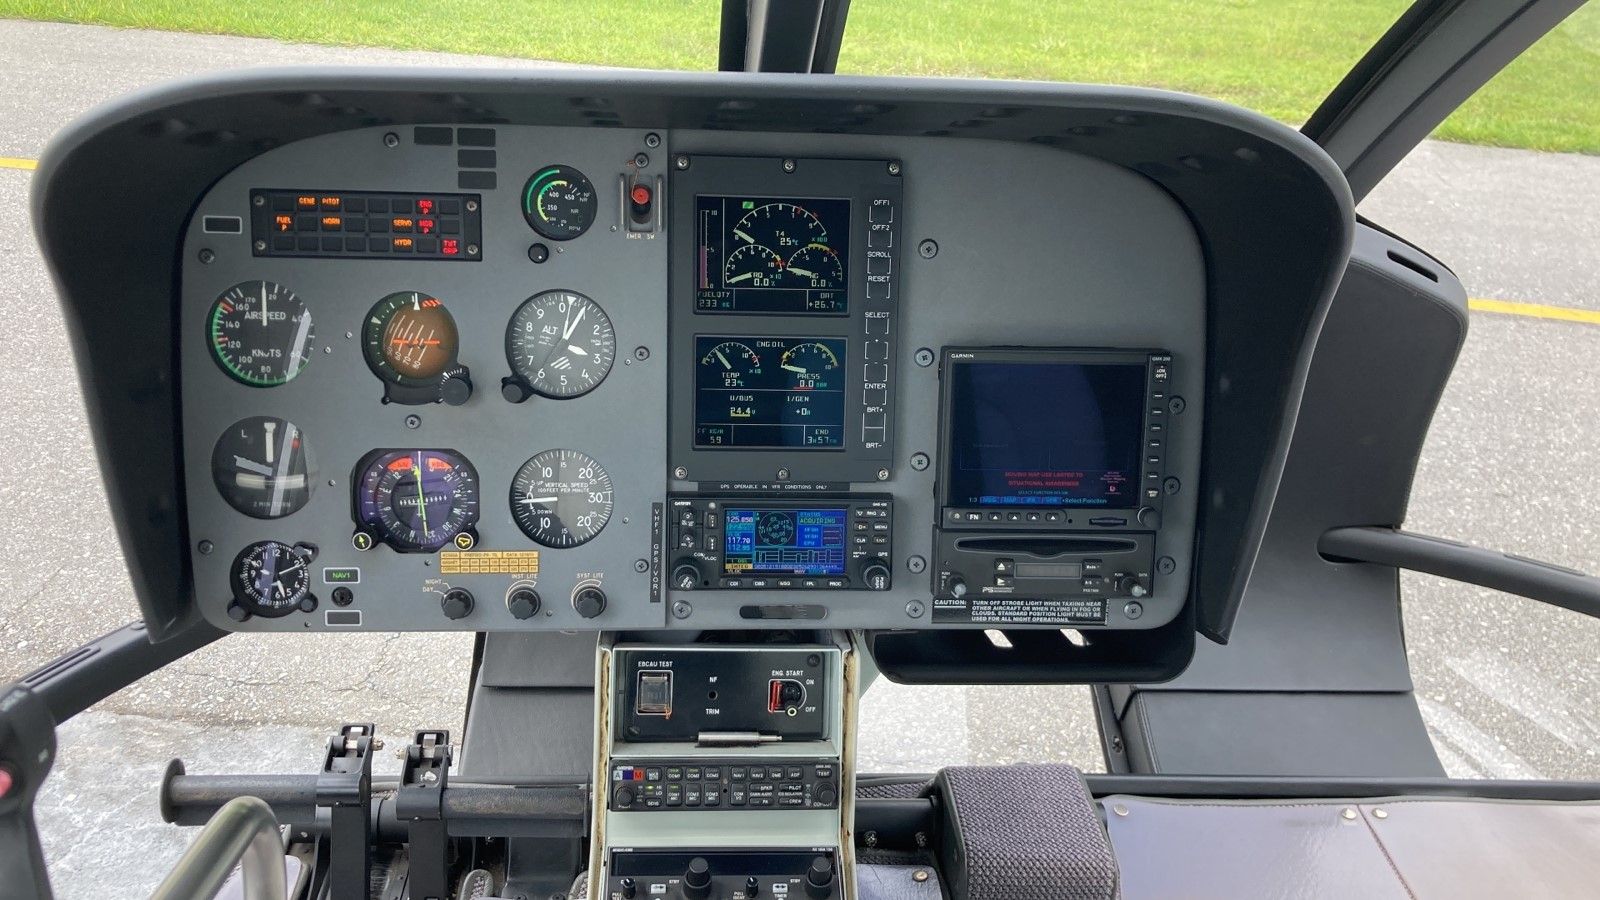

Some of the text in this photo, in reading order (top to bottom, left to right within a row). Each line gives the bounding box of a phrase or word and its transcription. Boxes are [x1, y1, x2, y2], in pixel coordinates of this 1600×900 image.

[299, 197, 316, 205] GENE
[276, 216, 291, 224] FUEL
[393, 219, 413, 227] SERVO
[753, 278, 770, 287] 0.0
[811, 279, 827, 287] 0.0
[235, 303, 250, 311] 160
[558, 302, 566, 313] 0
[700, 300, 717, 308] 233
[536, 308, 545, 320] 9
[225, 320, 240, 329] 140
[526, 321, 533, 332] 8
[542, 325, 558, 335] ALT
[593, 324, 600, 335] 2
[227, 341, 242, 349] 120
[239, 355, 253, 364] 100
[527, 355, 534, 366] 7
[593, 353, 601, 364] 3
[537, 368, 545, 379] 6
[581, 369, 589, 379] 4
[560, 375, 568, 386] 5
[799, 380, 814, 388] 0.0
[241, 429, 248, 438] L
[292, 429, 299, 438] R
[710, 436, 722, 444] 59
[542, 467, 553, 478] 10
[578, 468, 594, 479] 20
[588, 492, 603, 503] 30
[442, 521, 453, 531] 30
[540, 517, 551, 528] 10
[577, 516, 592, 527] 20
[728, 536, 751, 544] 117.70
[262, 552, 268, 560] 11
[272, 549, 281, 557] 12
[250, 569, 256, 578] 9
[298, 569, 304, 578] 3
[254, 581, 261, 589] 8
[294, 581, 300, 589] 4
[263, 588, 269, 596] 7
[275, 591, 281, 599] 6
[286, 588, 292, 596] 5
